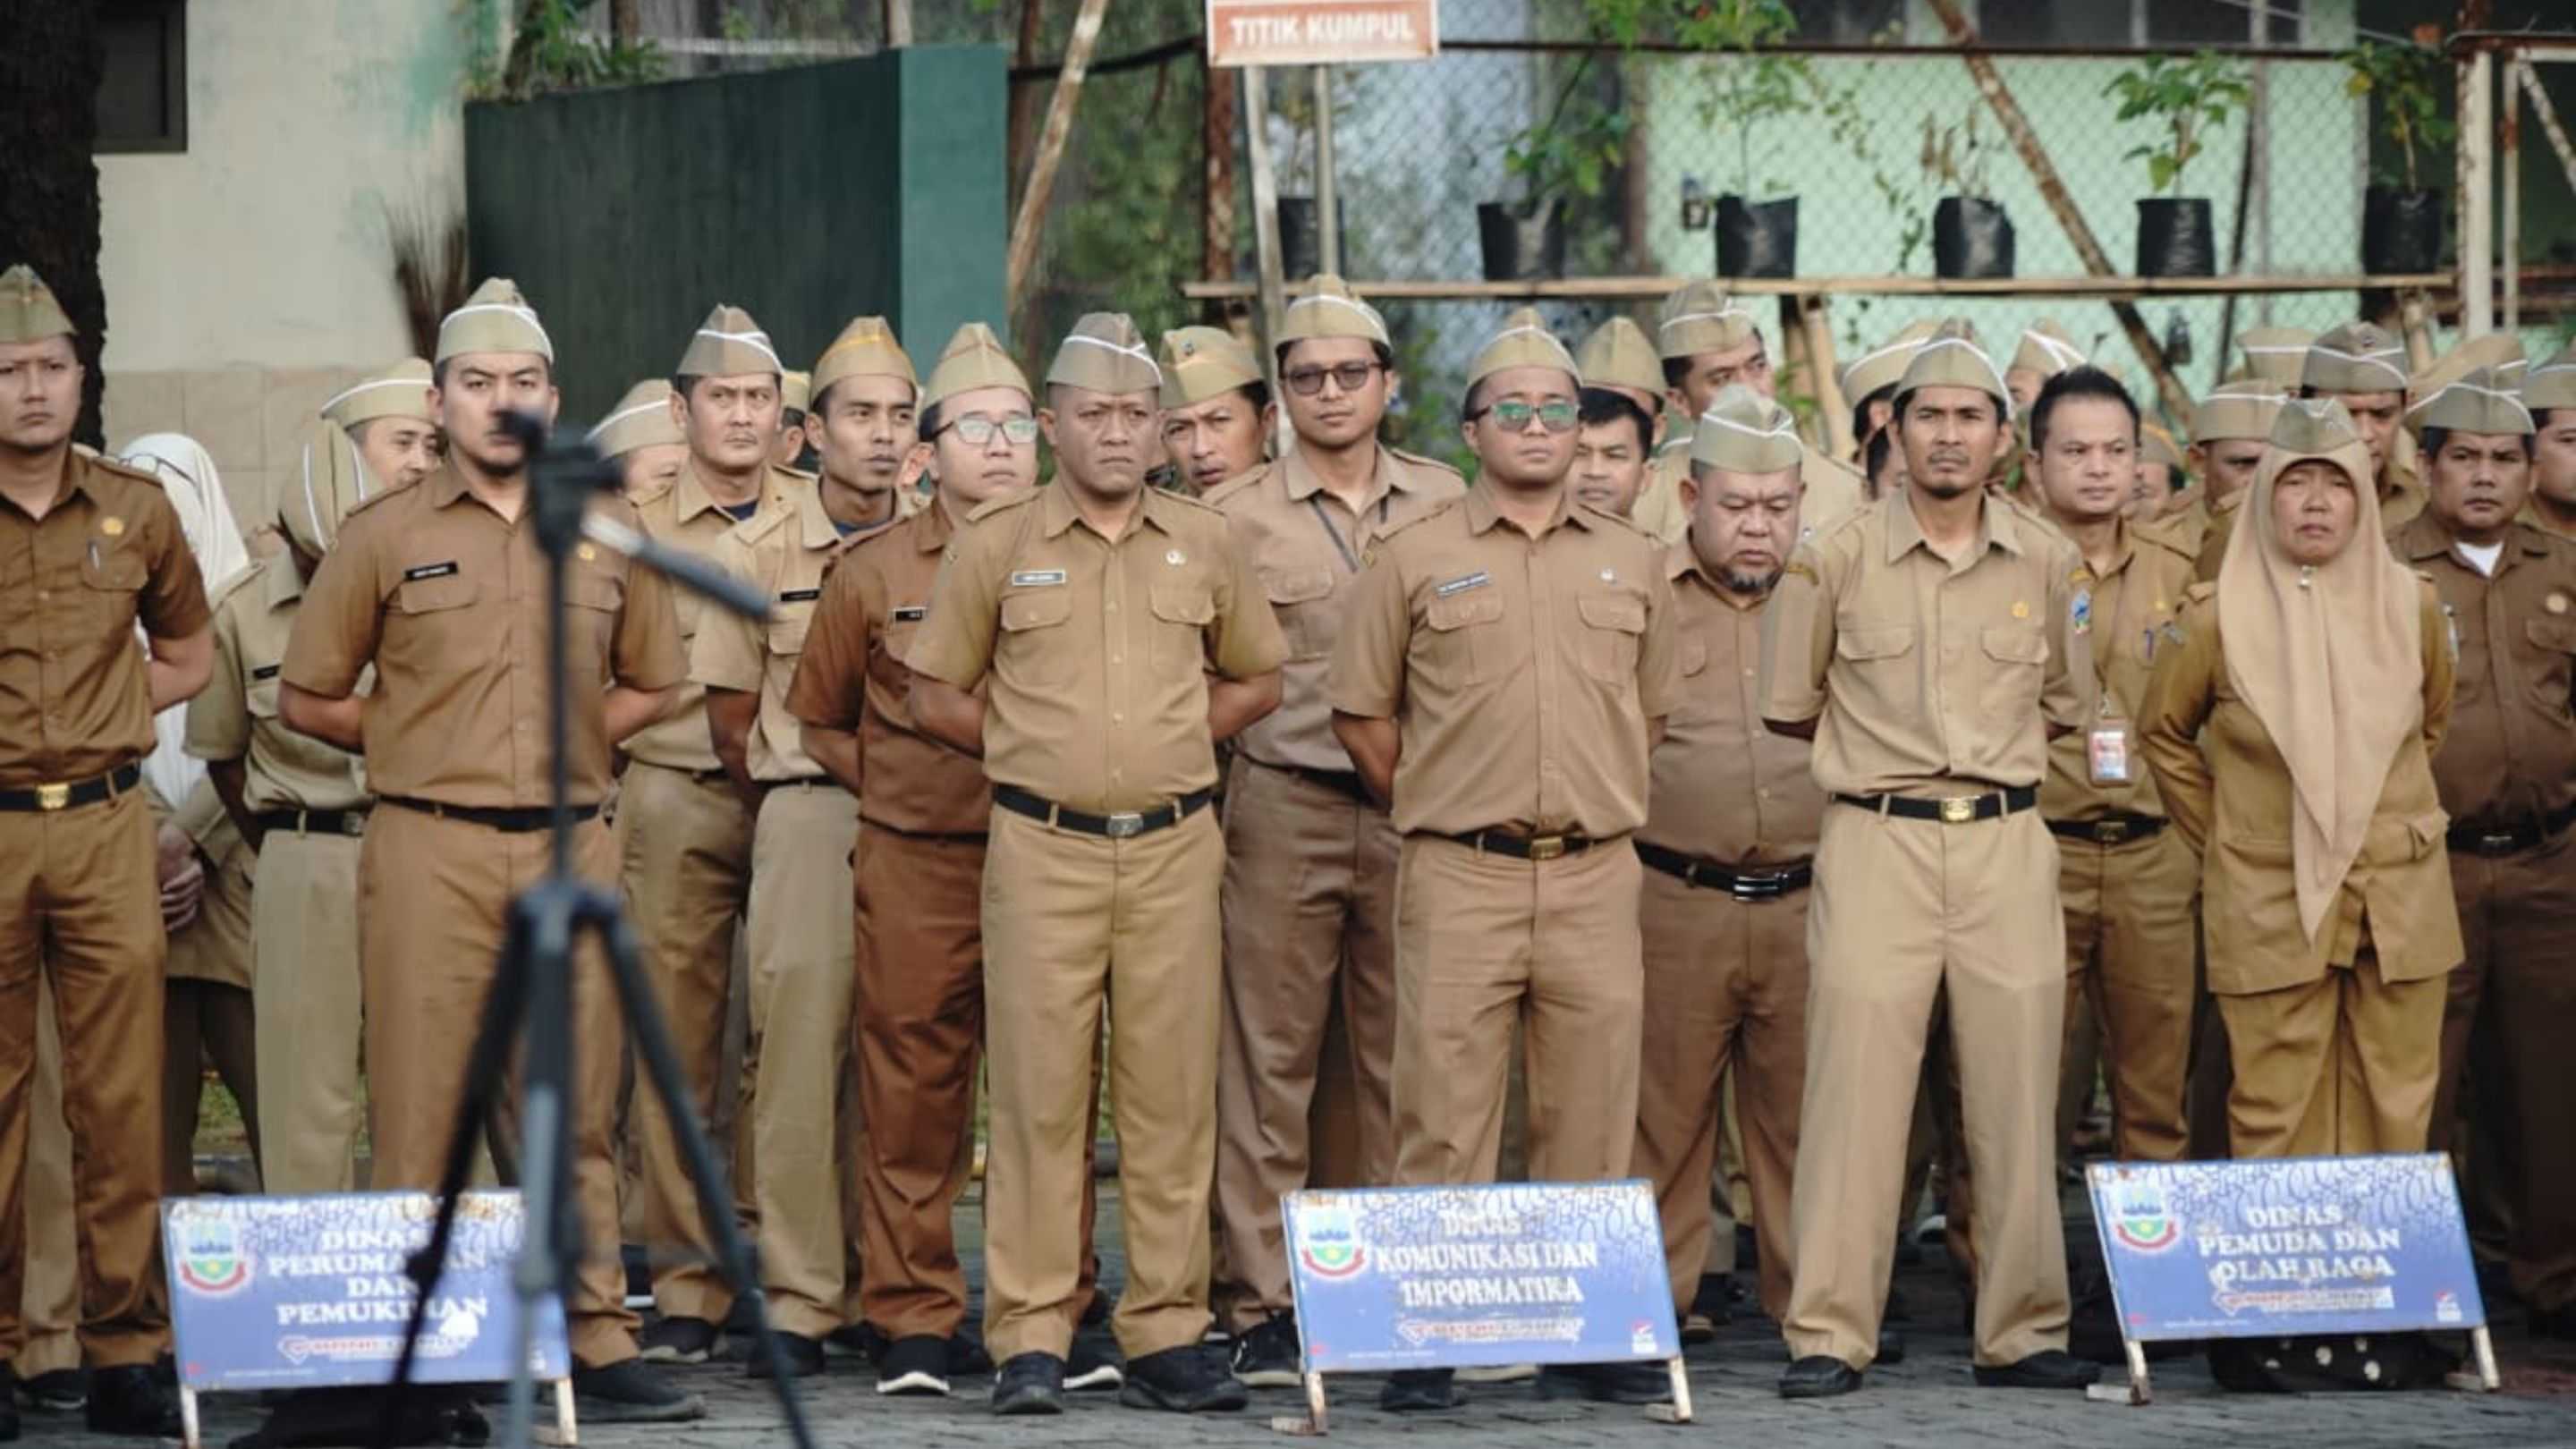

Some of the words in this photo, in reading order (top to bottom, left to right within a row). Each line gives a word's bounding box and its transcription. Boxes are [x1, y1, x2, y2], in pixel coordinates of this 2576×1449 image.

[1232, 17, 1297, 44] TITIK
[1307, 13, 1415, 42] KUMPUL
[1378, 1244, 1538, 1272] KOMUNIKASI
[1545, 1242, 1597, 1267] DAN
[2199, 1232, 2327, 1256] PEMUDA
[2334, 1229, 2400, 1250] DAN
[2216, 1258, 2300, 1282] OLAH
[1402, 1277, 1583, 1306] IMPORMATIKA
